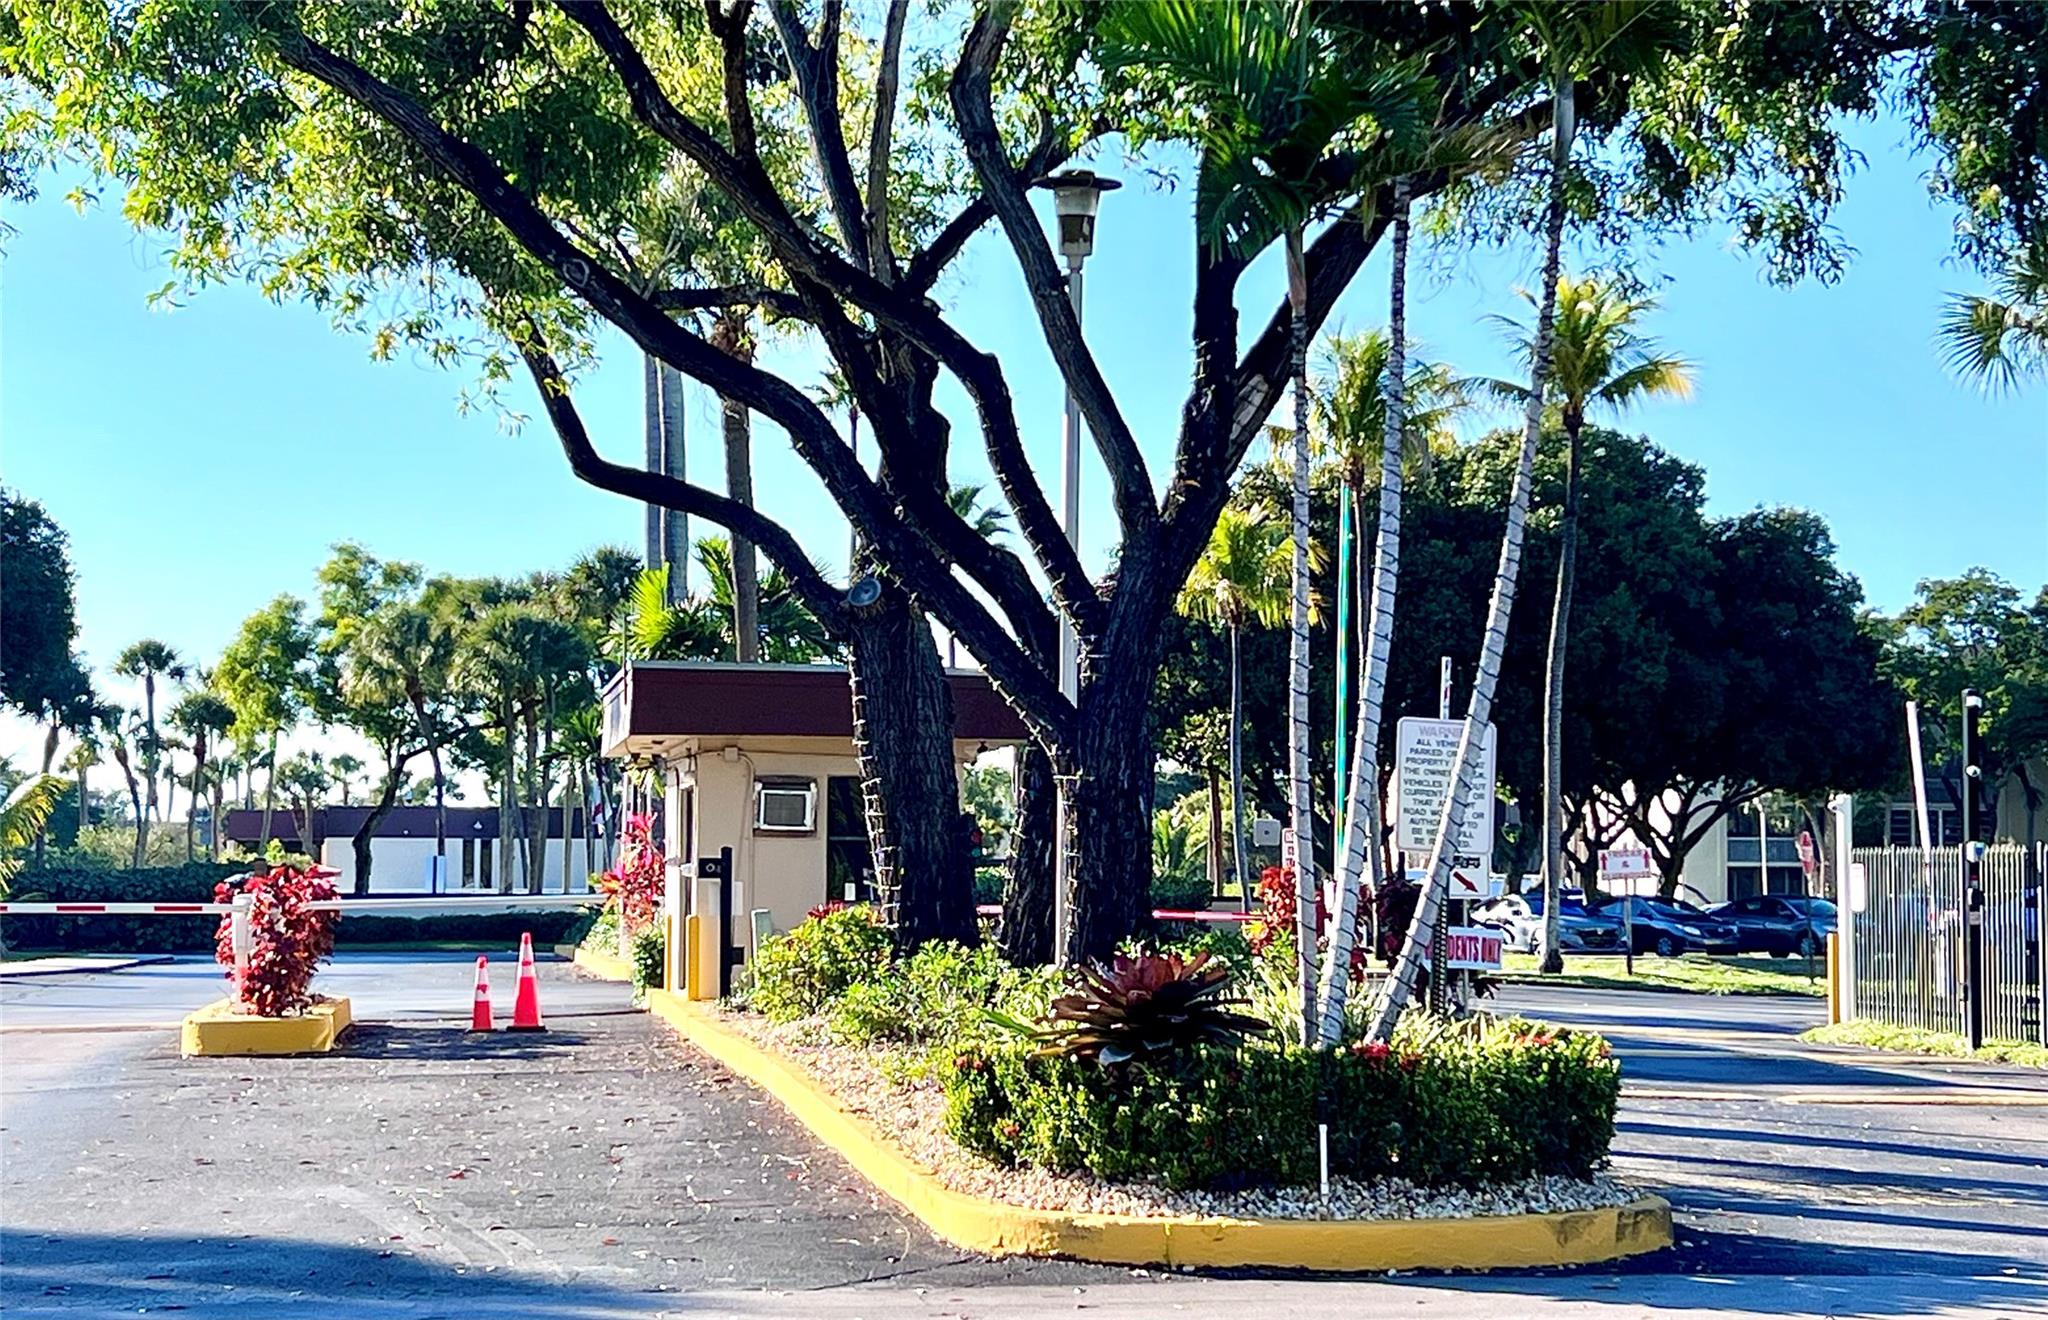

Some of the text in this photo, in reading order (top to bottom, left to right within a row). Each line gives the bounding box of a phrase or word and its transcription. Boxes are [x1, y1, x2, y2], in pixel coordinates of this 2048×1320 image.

[1405, 757, 1450, 766] PROPERTY
[1404, 766, 1420, 775] THE
[1403, 778, 1442, 788] VEHICLES
[1403, 788, 1443, 797] CURRENT
[1412, 798, 1433, 806] THAT
